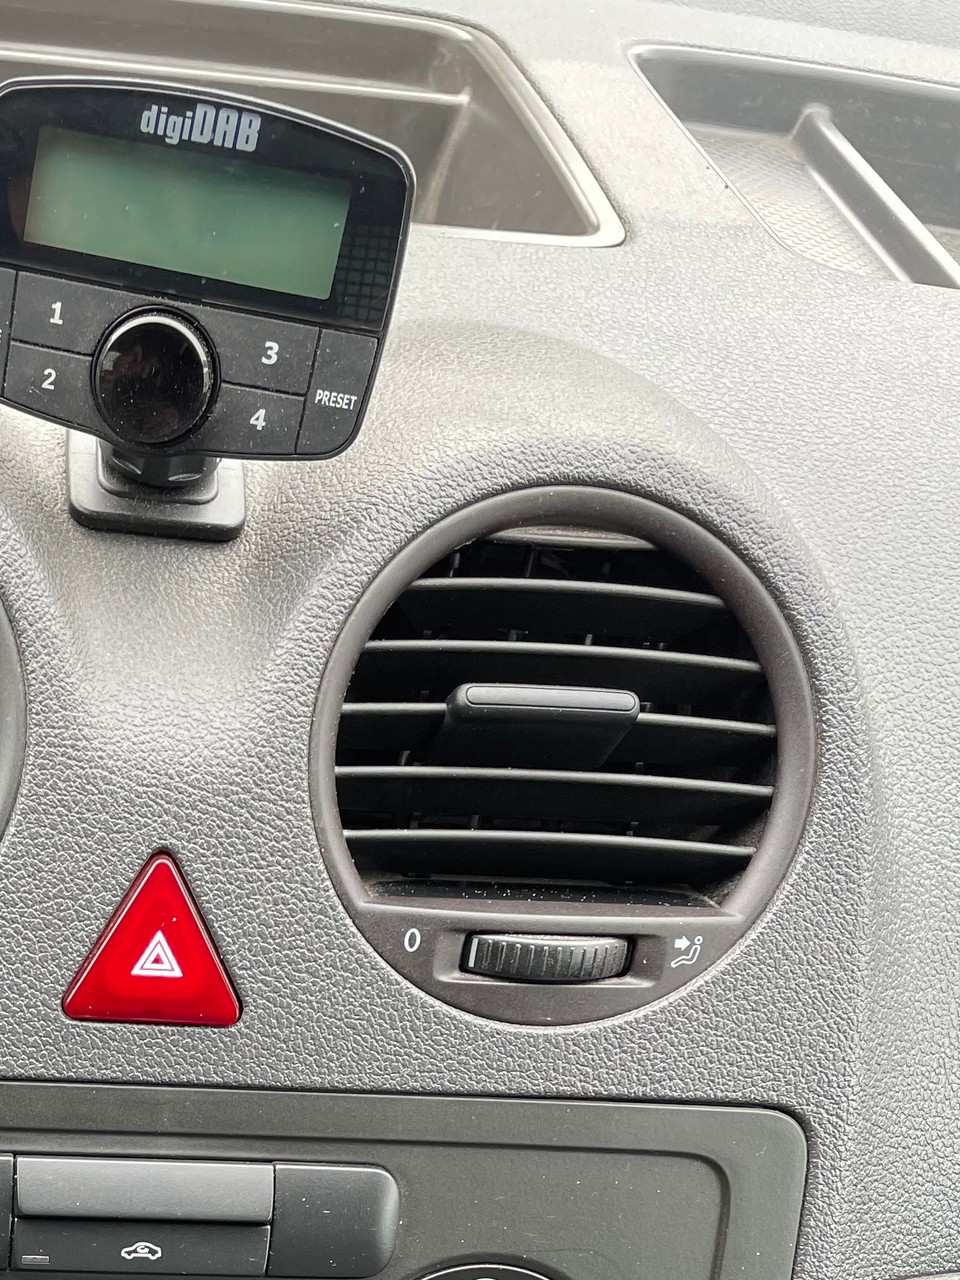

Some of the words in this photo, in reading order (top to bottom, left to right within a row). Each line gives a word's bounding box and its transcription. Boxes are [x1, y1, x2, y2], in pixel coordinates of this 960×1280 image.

[140, 102, 262, 153] digiDAB
[48, 301, 64, 325] 1
[261, 341, 279, 365] 3
[41, 368, 56, 390] 2
[314, 388, 358, 412] PRESET
[249, 408, 266, 431] 4
